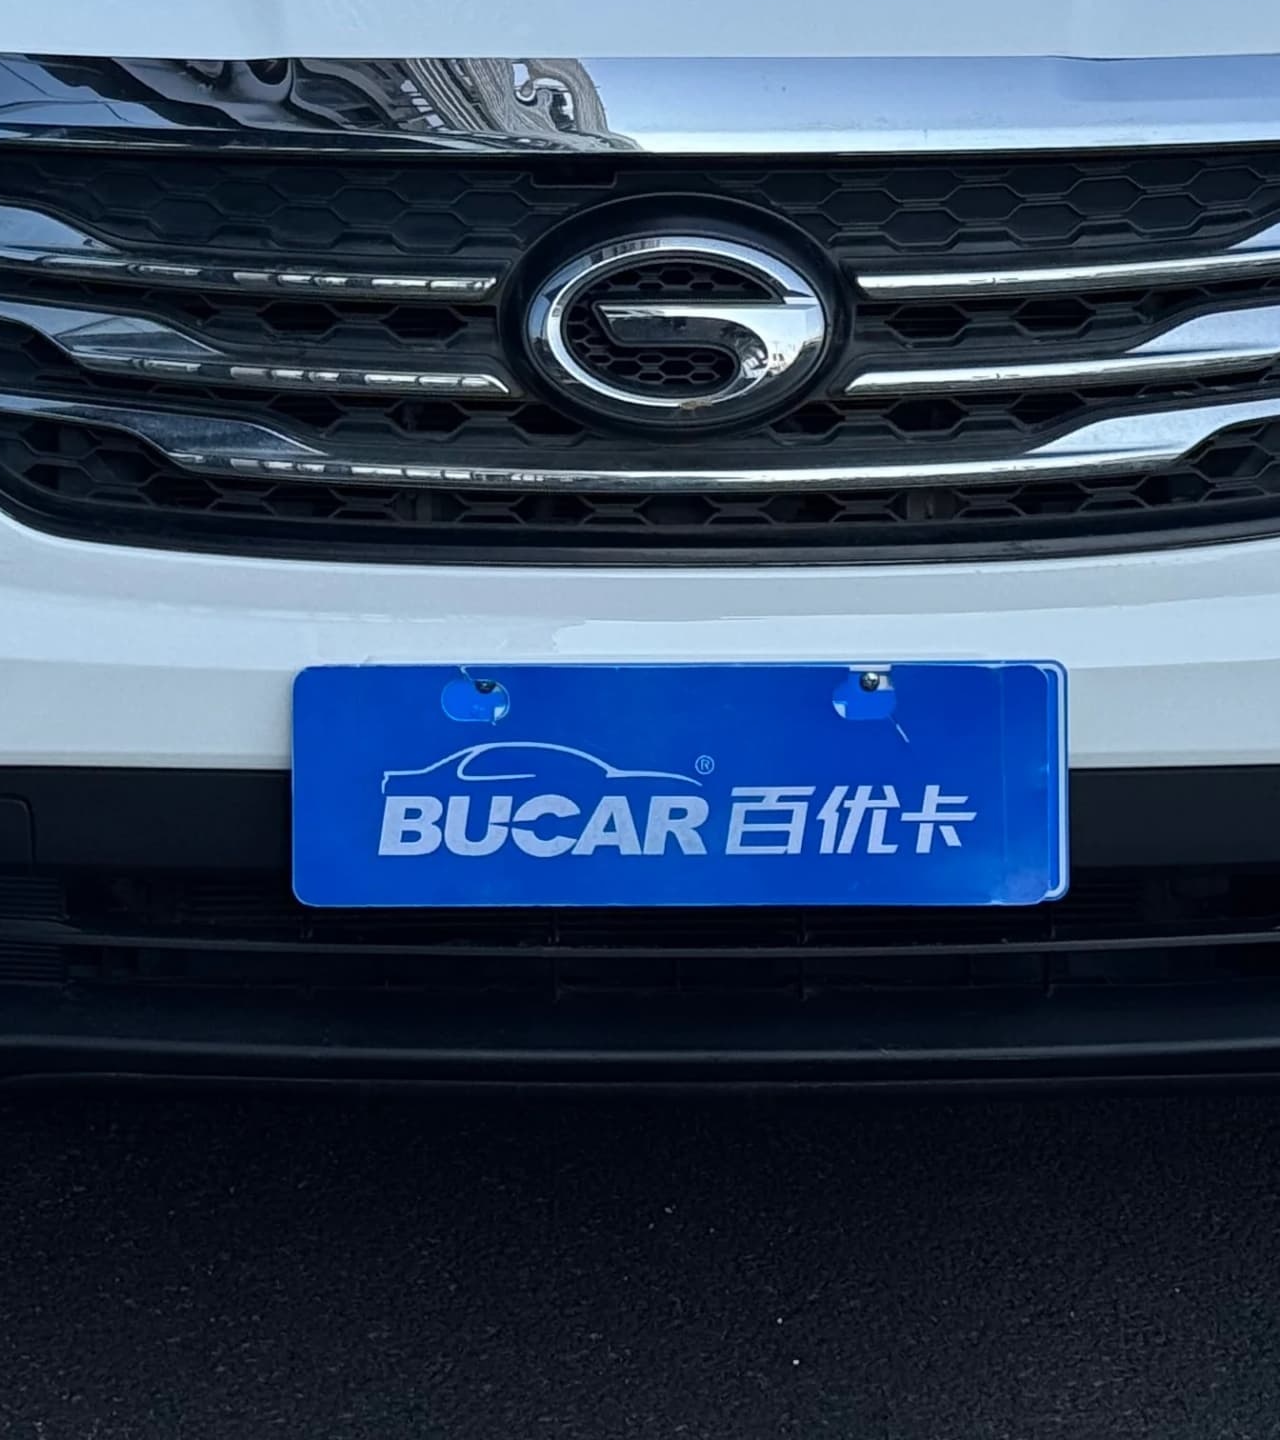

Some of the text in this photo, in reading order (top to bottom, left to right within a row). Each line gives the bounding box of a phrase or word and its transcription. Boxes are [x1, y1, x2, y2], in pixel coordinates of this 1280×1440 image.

[376, 784, 977, 858] BUCAR 百优卡
